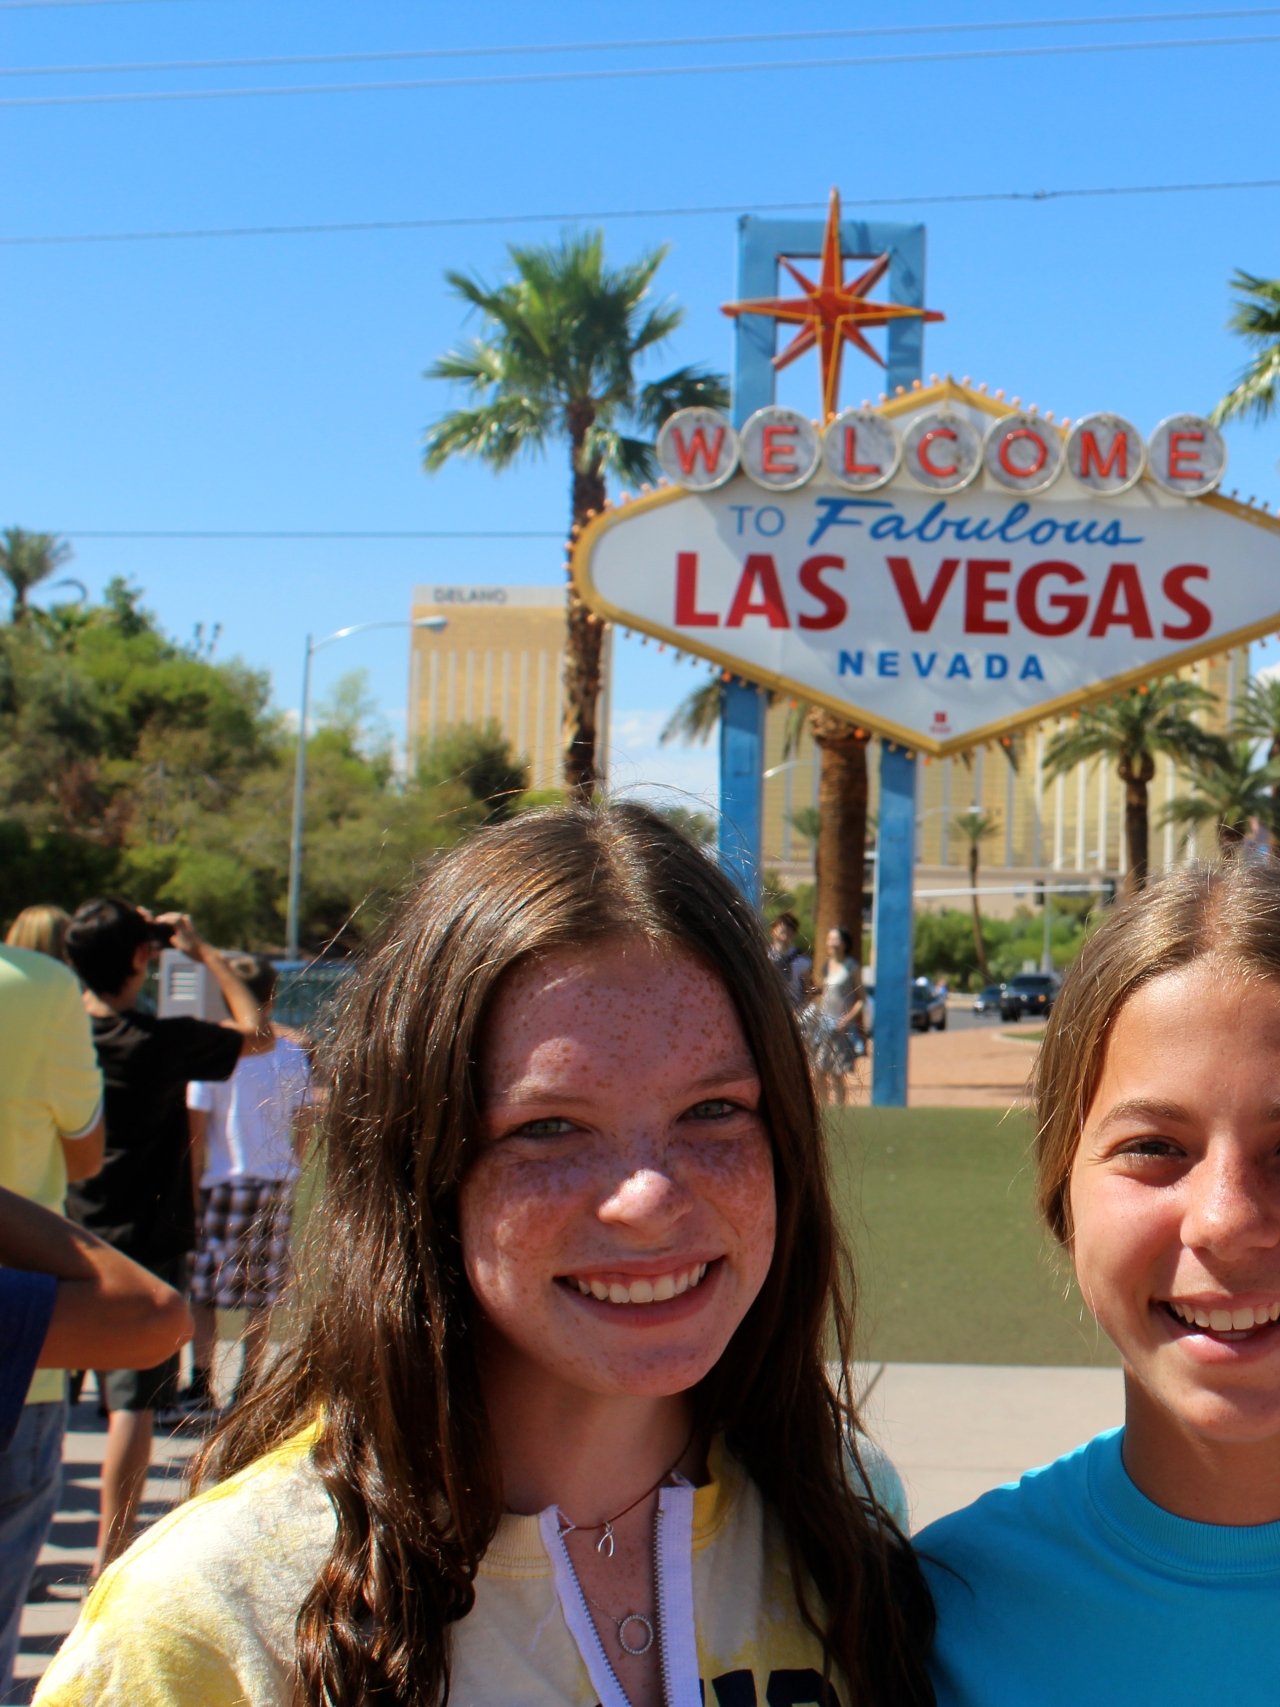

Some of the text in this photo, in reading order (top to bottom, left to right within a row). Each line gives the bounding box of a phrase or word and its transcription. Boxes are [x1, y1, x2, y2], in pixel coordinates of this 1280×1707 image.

[671, 425, 1206, 480] WELCOME
[730, 496, 1145, 547] TO Fabulous
[433, 588, 506, 604] DELANO
[674, 551, 1214, 641] LAS VEGAS
[838, 650, 1045, 681] NEVADA
